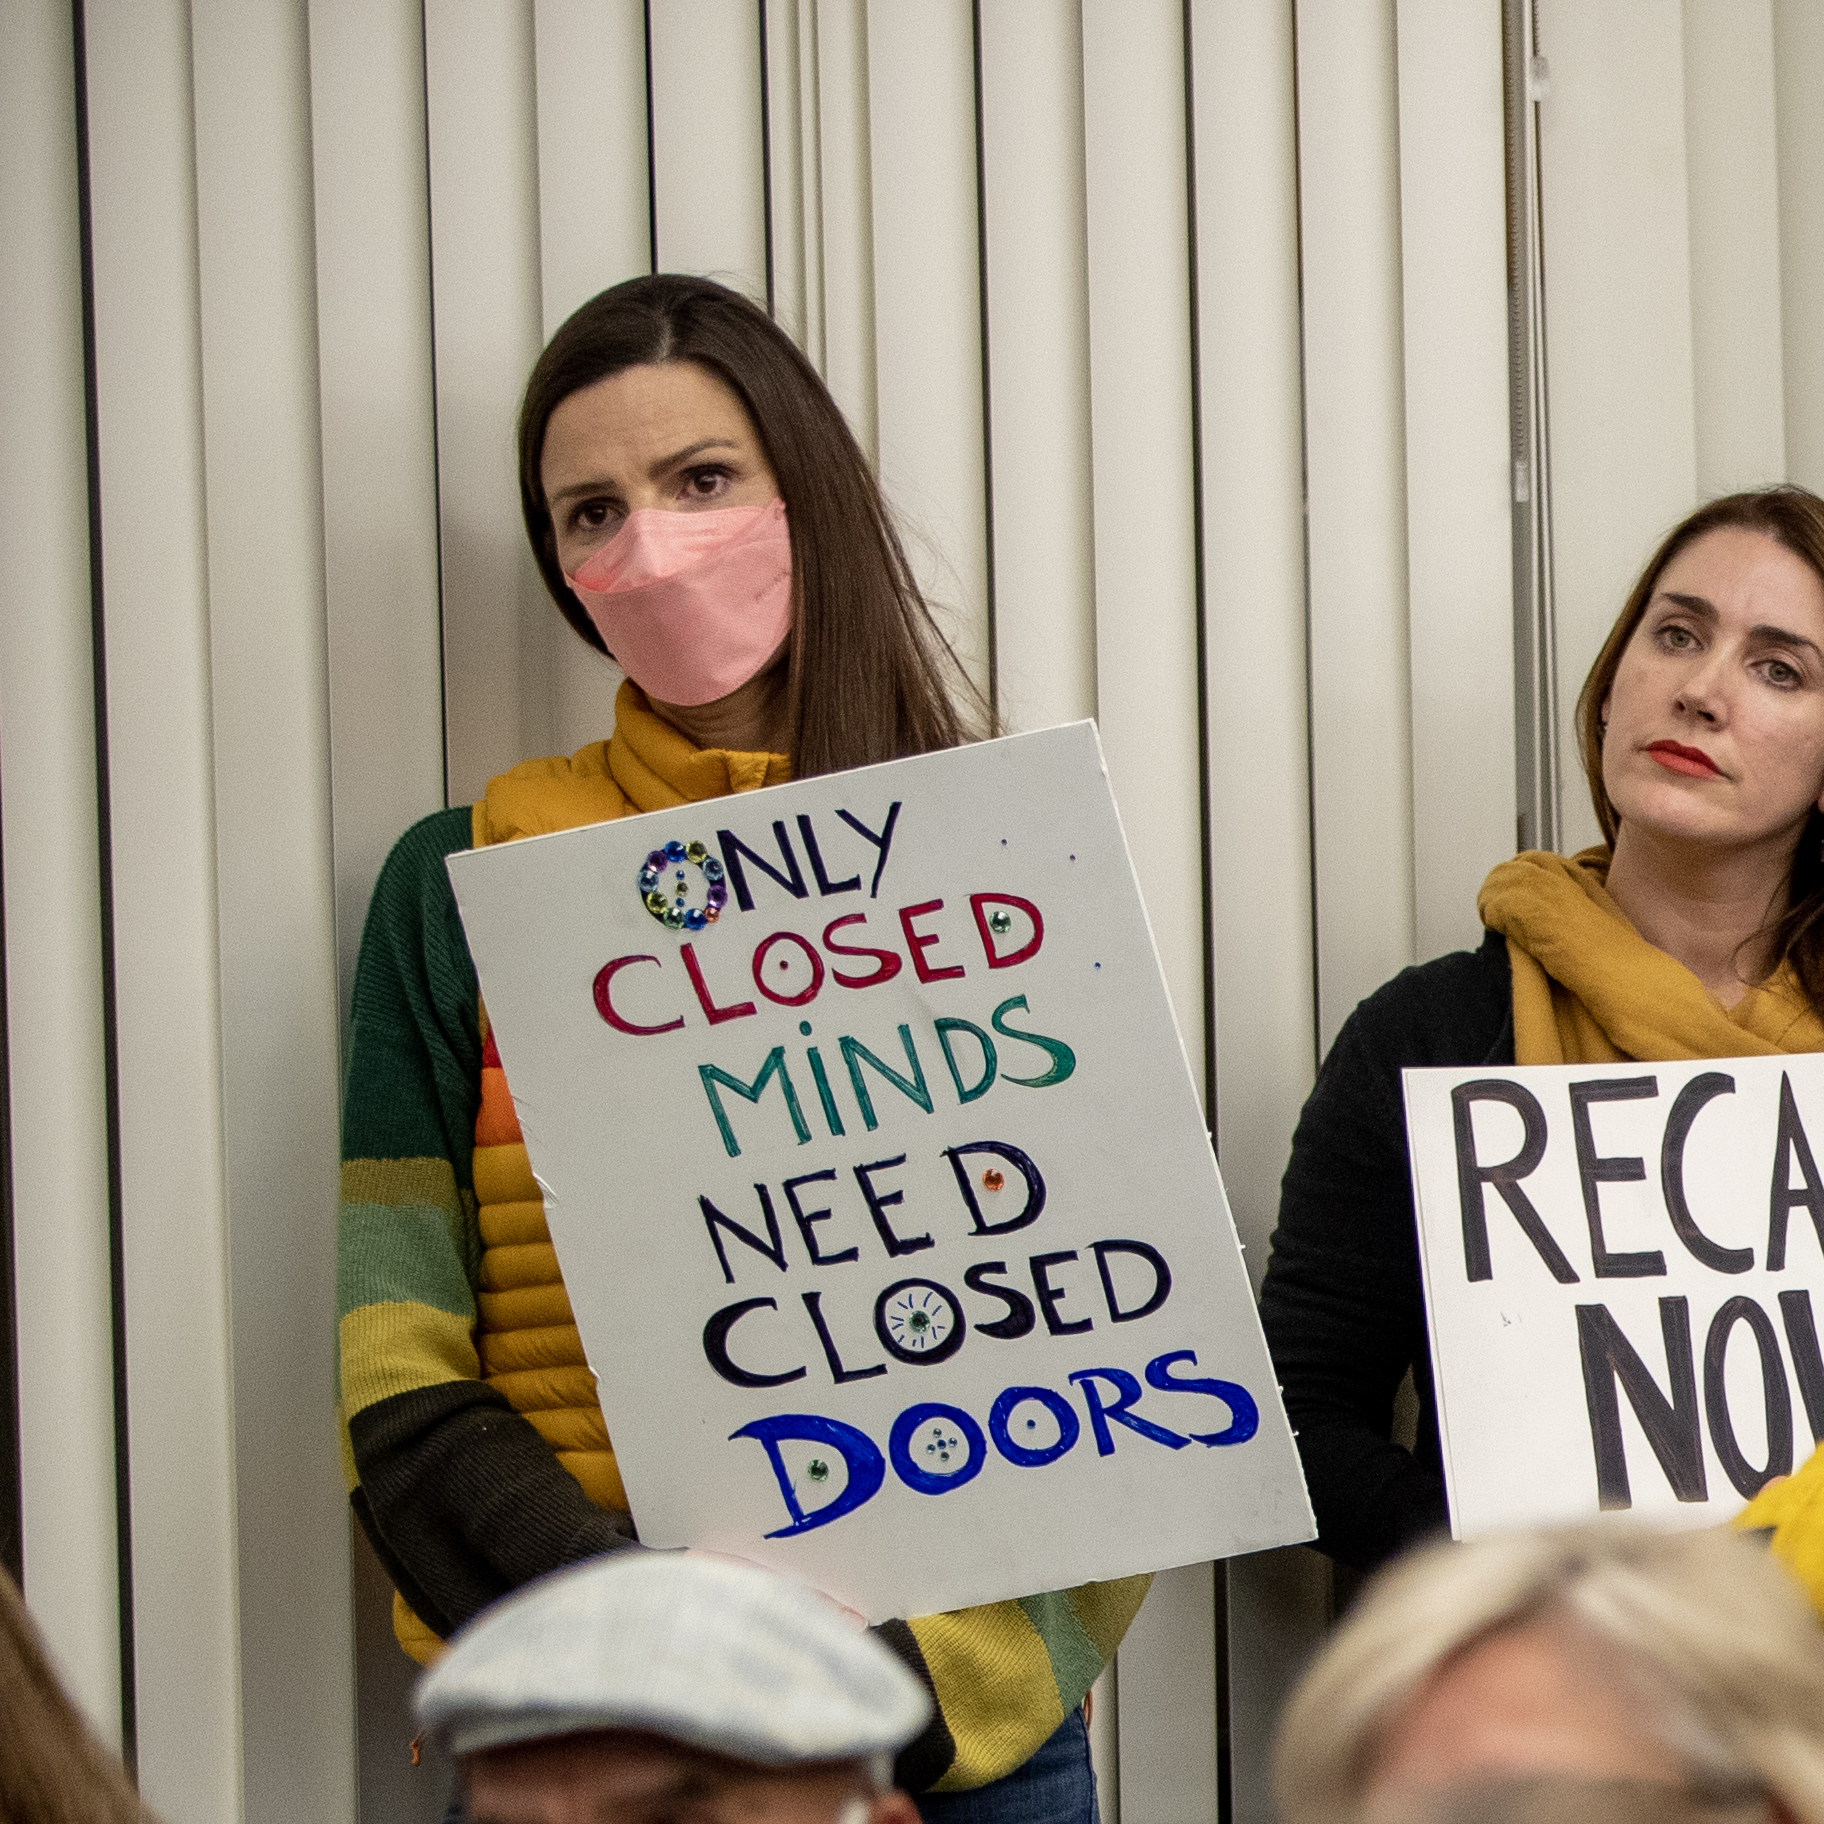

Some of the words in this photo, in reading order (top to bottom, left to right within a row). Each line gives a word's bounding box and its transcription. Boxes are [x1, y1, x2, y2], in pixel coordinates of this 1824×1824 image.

[637, 802, 902, 931] ONLY
[593, 892, 1045, 1036] CLOSED
[697, 1140, 1047, 1284] NEED
[702, 1239, 1172, 1389] CLOSED
[727, 1350, 1260, 1540] DOORS
